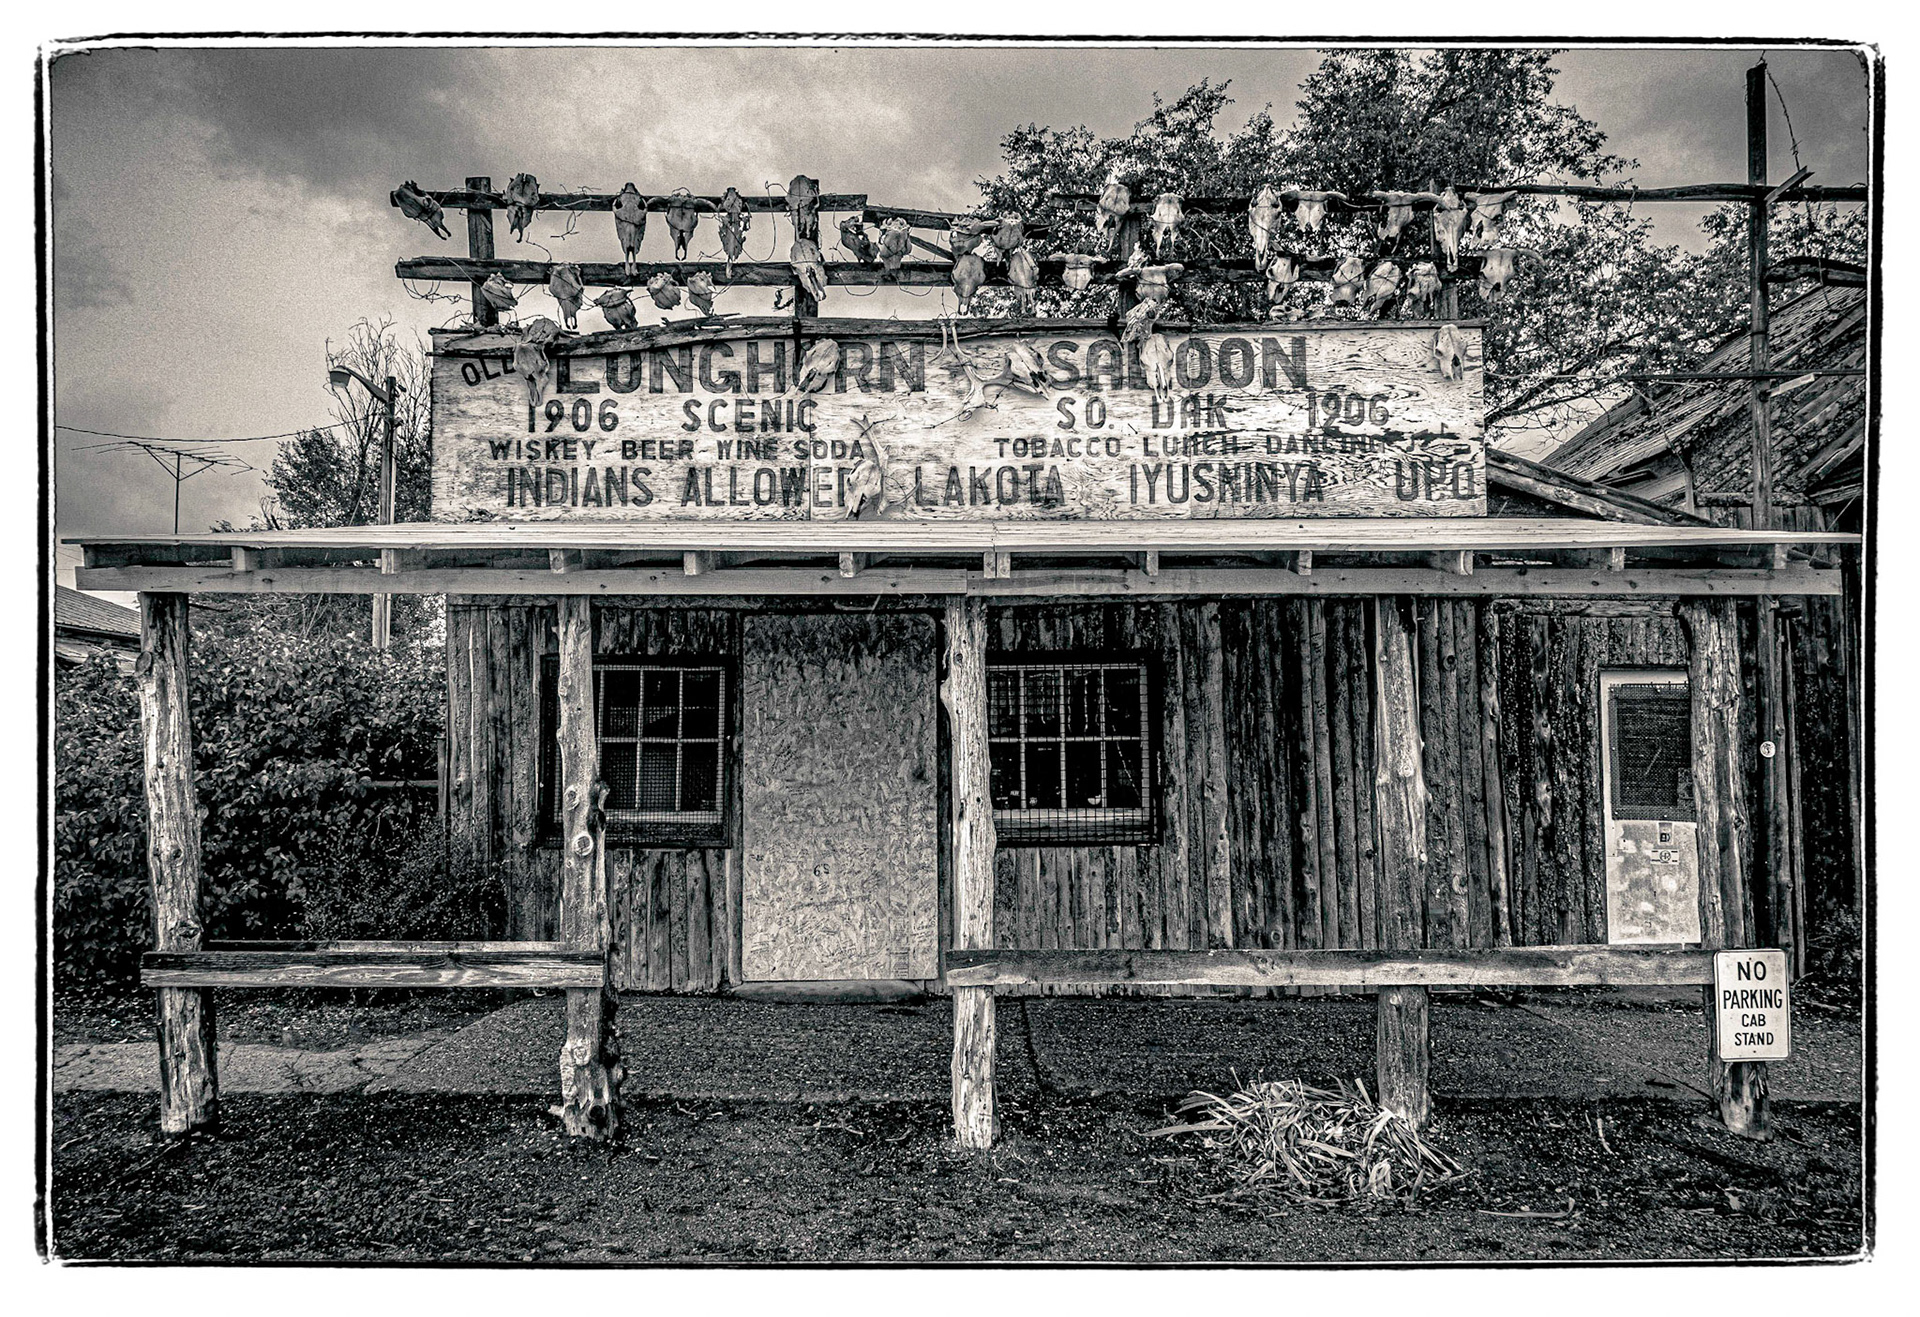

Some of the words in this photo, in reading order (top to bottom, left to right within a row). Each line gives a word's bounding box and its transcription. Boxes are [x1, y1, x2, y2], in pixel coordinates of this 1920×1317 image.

[557, 341, 925, 394] LONGHRN
[528, 398, 620, 432] 1906
[681, 399, 818, 433] SCENIC
[1057, 397, 1115, 429] SO.
[1152, 394, 1228, 429] DAK
[1306, 392, 1390, 427] 1906
[489, 439, 597, 460] WISKEY
[621, 440, 695, 460] BEER
[716, 440, 778, 460] WINE
[793, 439, 865, 460] SODA
[993, 436, 1121, 458] TOBACCO
[1143, 434, 1239, 458] LUNCH
[507, 466, 654, 508] INDIANS
[914, 464, 1066, 507] LAKOTA
[1737, 961, 1767, 981] NO
[1723, 988, 1783, 1009] PARKING
[1741, 1013, 1766, 1027] CAB
[1734, 1032, 1774, 1046] STAND
